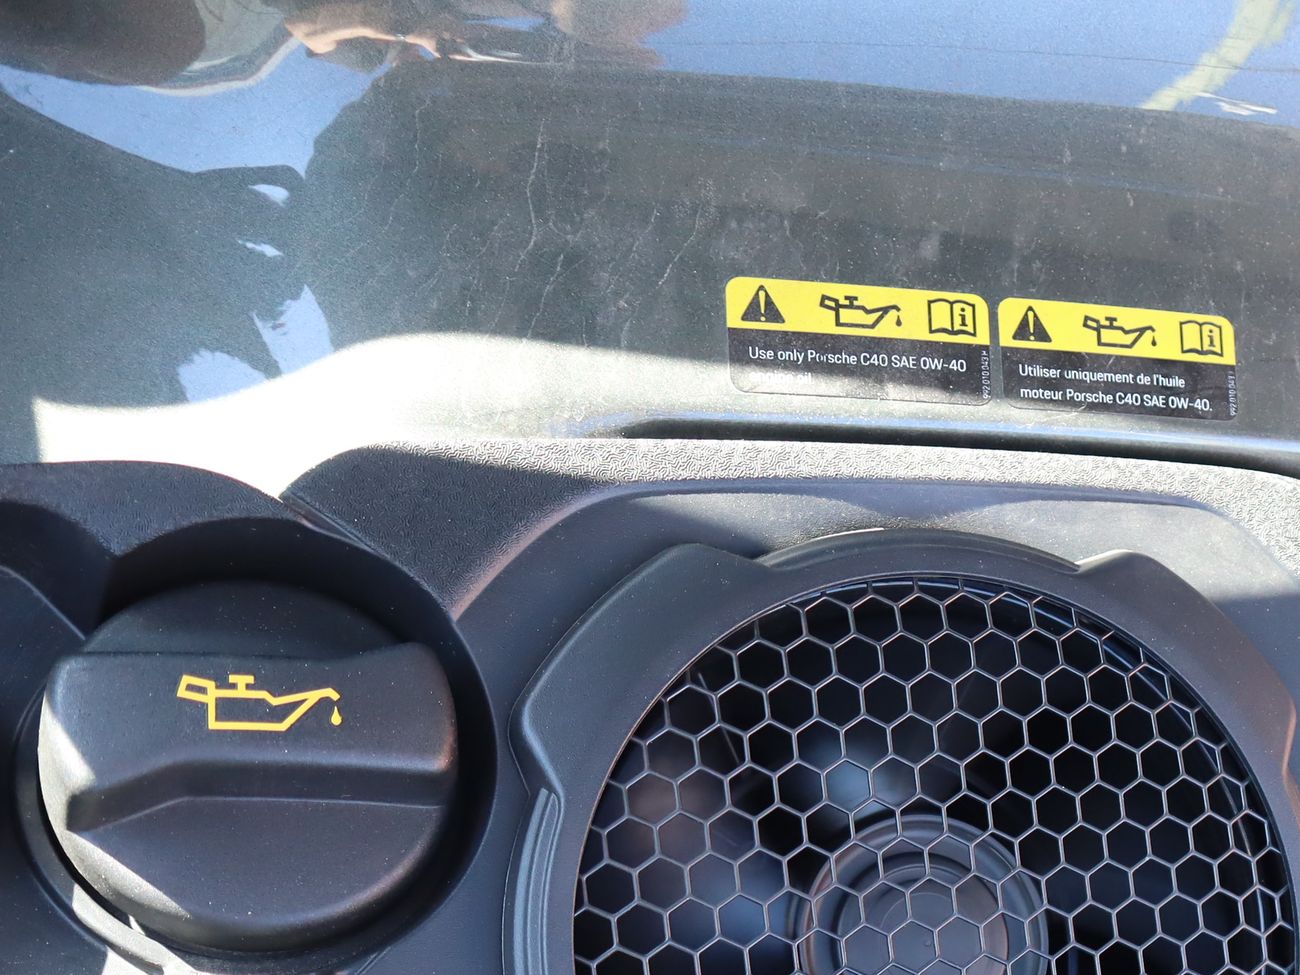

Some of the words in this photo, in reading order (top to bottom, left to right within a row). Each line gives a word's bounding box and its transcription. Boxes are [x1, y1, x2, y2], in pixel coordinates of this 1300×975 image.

[748, 346, 774, 360] Use
[777, 349, 804, 363] only
[807, 350, 858, 365] Porsche
[860, 353, 888, 367] C40
[891, 355, 917, 369] SAE
[920, 358, 967, 373] 0W-40
[1018, 363, 1062, 379] Utiliser
[1064, 370, 1134, 386] uniquement
[1137, 374, 1151, 386] de
[1152, 374, 1186, 388] l'huile
[1020, 387, 1063, 401] moteur
[1066, 389, 1114, 404] Porsche
[1116, 392, 1141, 406] C40
[1143, 395, 1166, 408] SAE
[1169, 398, 1213, 412] 0W-40.
